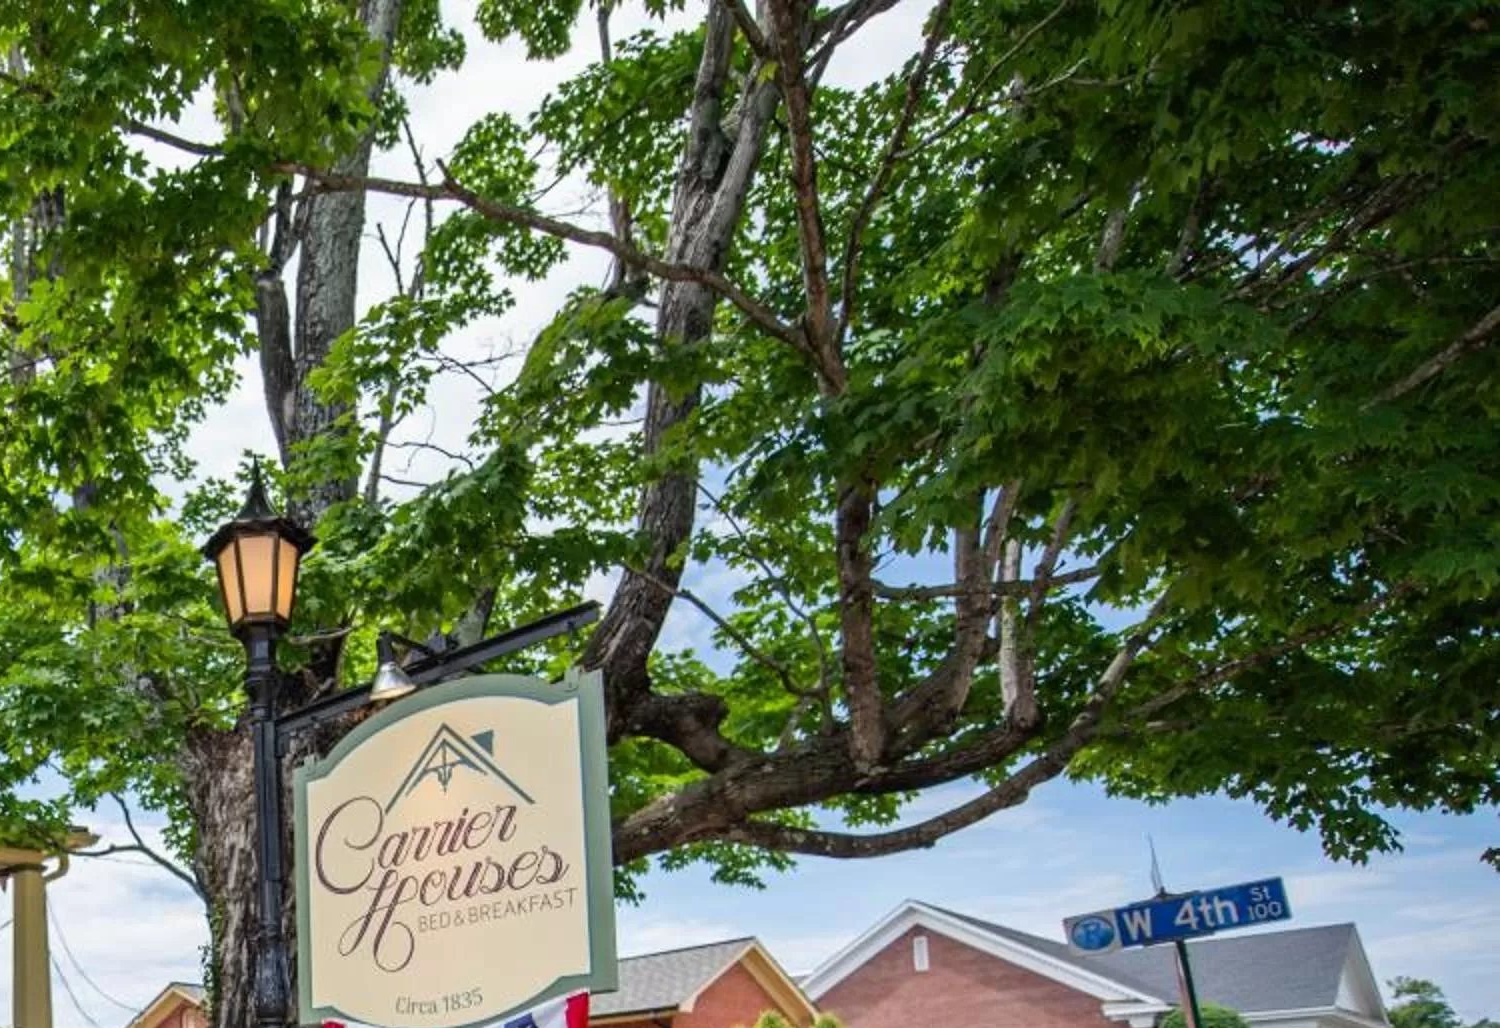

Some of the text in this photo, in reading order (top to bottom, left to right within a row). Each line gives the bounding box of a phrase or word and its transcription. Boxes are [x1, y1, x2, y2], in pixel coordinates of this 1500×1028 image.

[315, 795, 517, 895] Carrier
[338, 845, 569, 973] Houses
[1248, 900, 1283, 921] 100
[1251, 884, 1271, 902] St
[1122, 896, 1239, 942] W 4th
[395, 986, 484, 1015] Circa 1835
